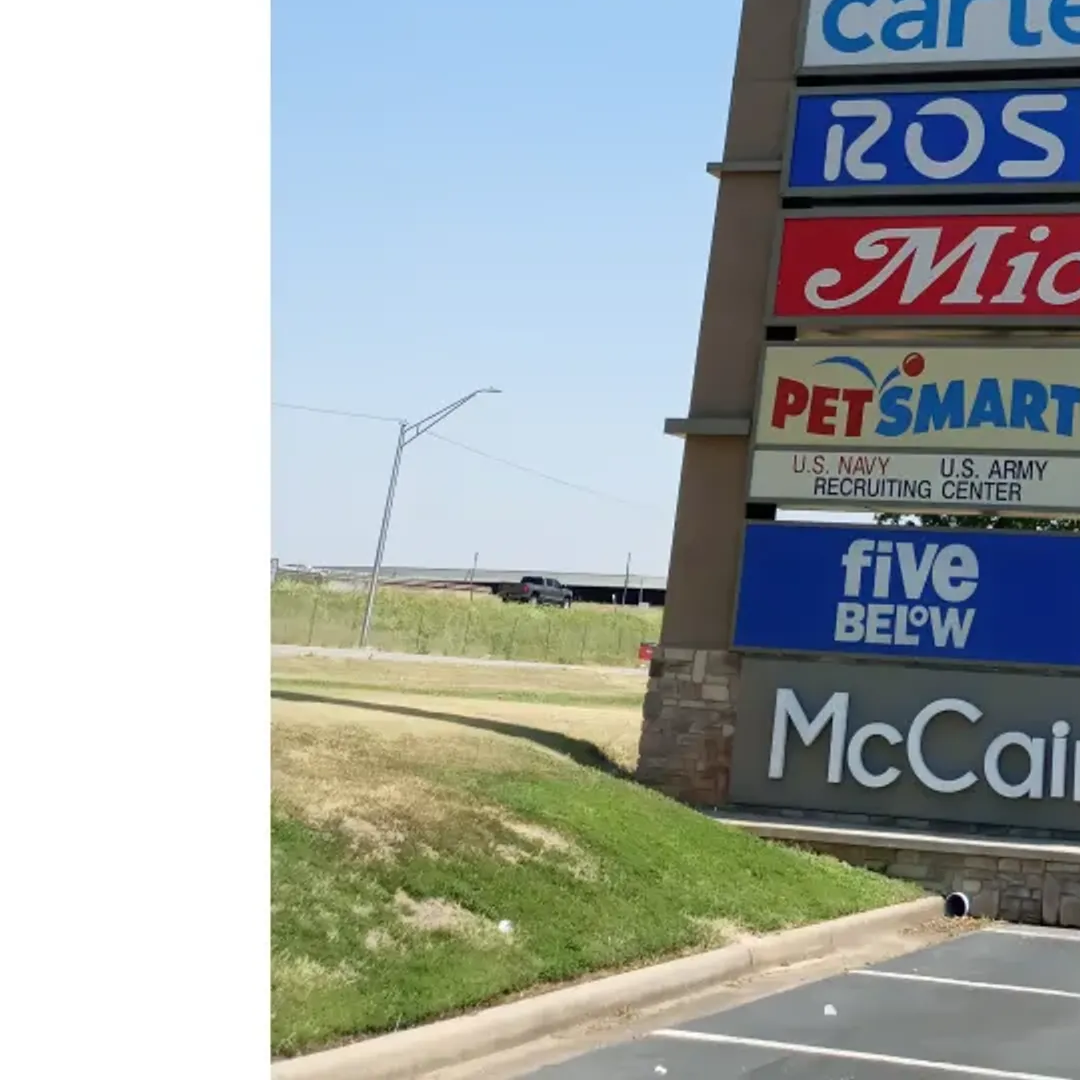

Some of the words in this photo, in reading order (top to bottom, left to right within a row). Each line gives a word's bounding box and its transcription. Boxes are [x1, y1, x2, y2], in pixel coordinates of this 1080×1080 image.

[793, 455, 830, 475] U.S.
[837, 456, 890, 477] NAVY
[940, 458, 982, 478] U.S.
[988, 459, 1048, 482] ARMY
[813, 476, 932, 500] RECRUITING
[941, 480, 1022, 502] CENTER
